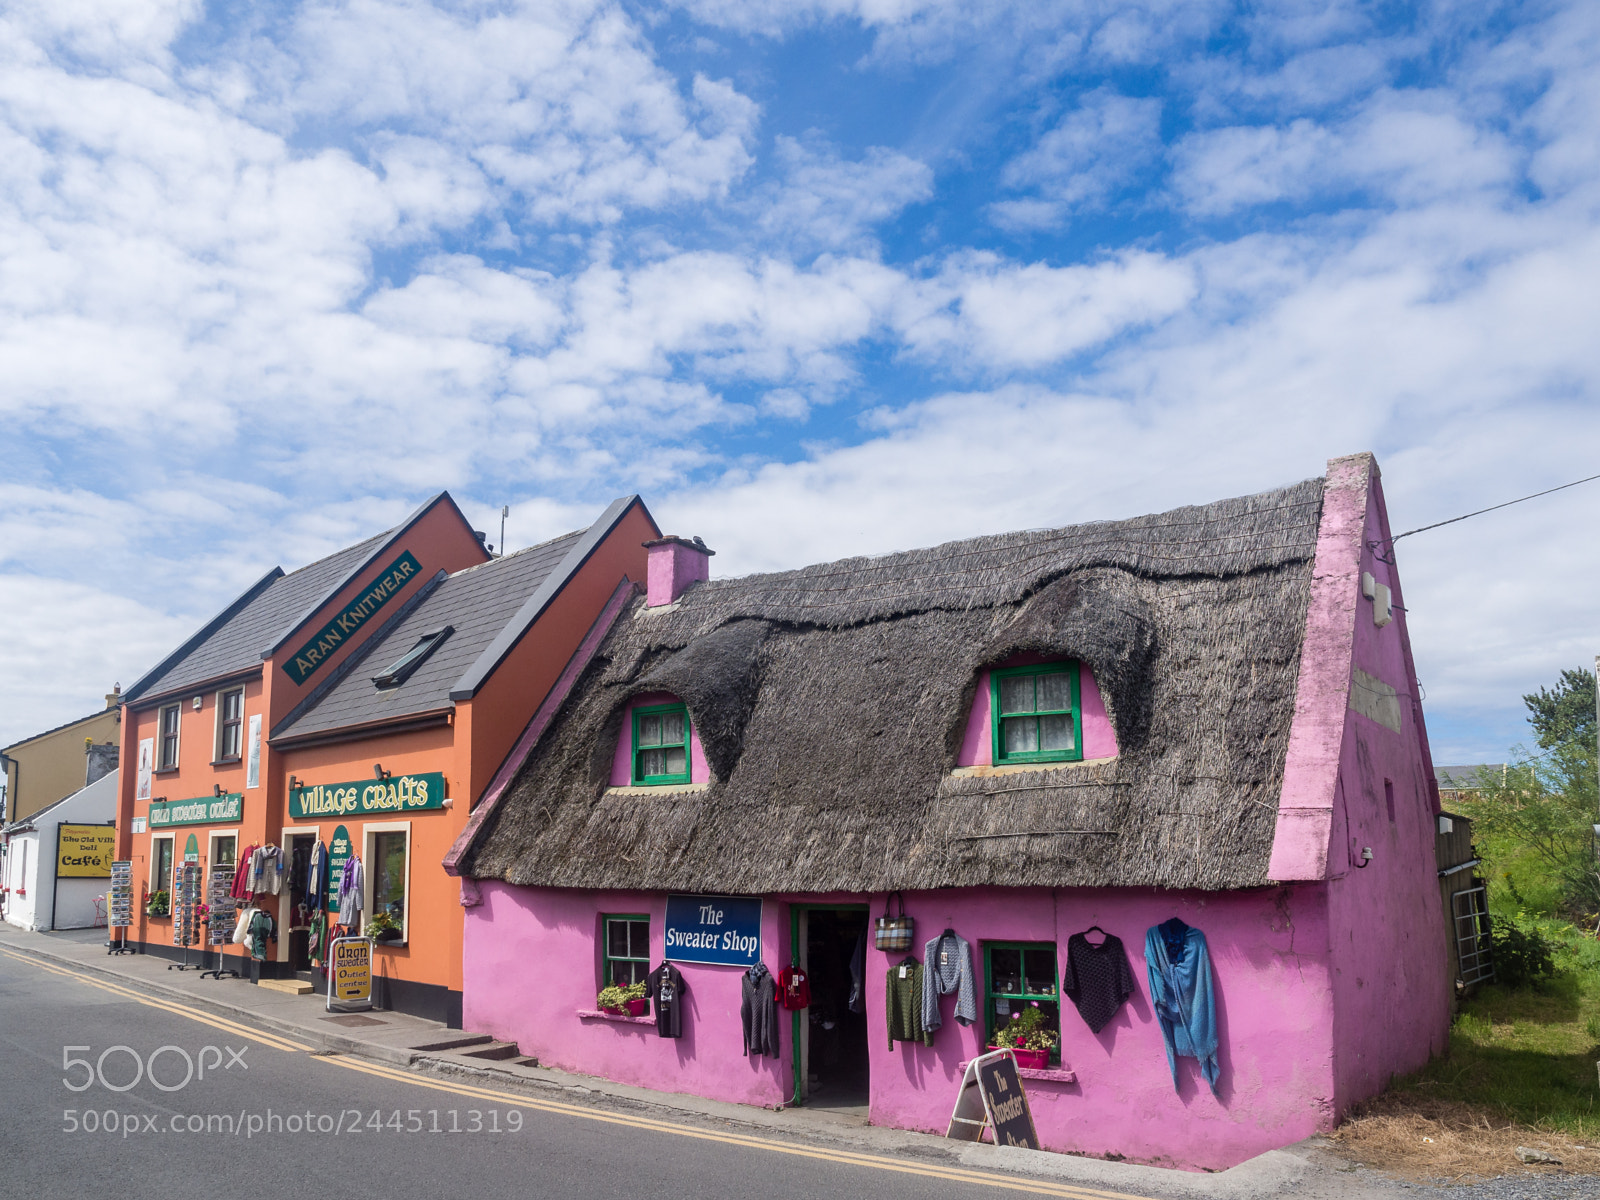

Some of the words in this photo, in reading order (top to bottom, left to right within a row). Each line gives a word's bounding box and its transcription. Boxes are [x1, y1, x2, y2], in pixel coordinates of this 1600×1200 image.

[295, 628, 342, 676] ARAN
[336, 560, 415, 634] KNITWEAR
[61, 855, 102, 867] Café
[699, 904, 724, 926] The
[666, 927, 720, 950] Sweater
[722, 929, 758, 958] Shop
[339, 969, 368, 979] Outlet
[989, 1091, 1024, 1126] Sweater
